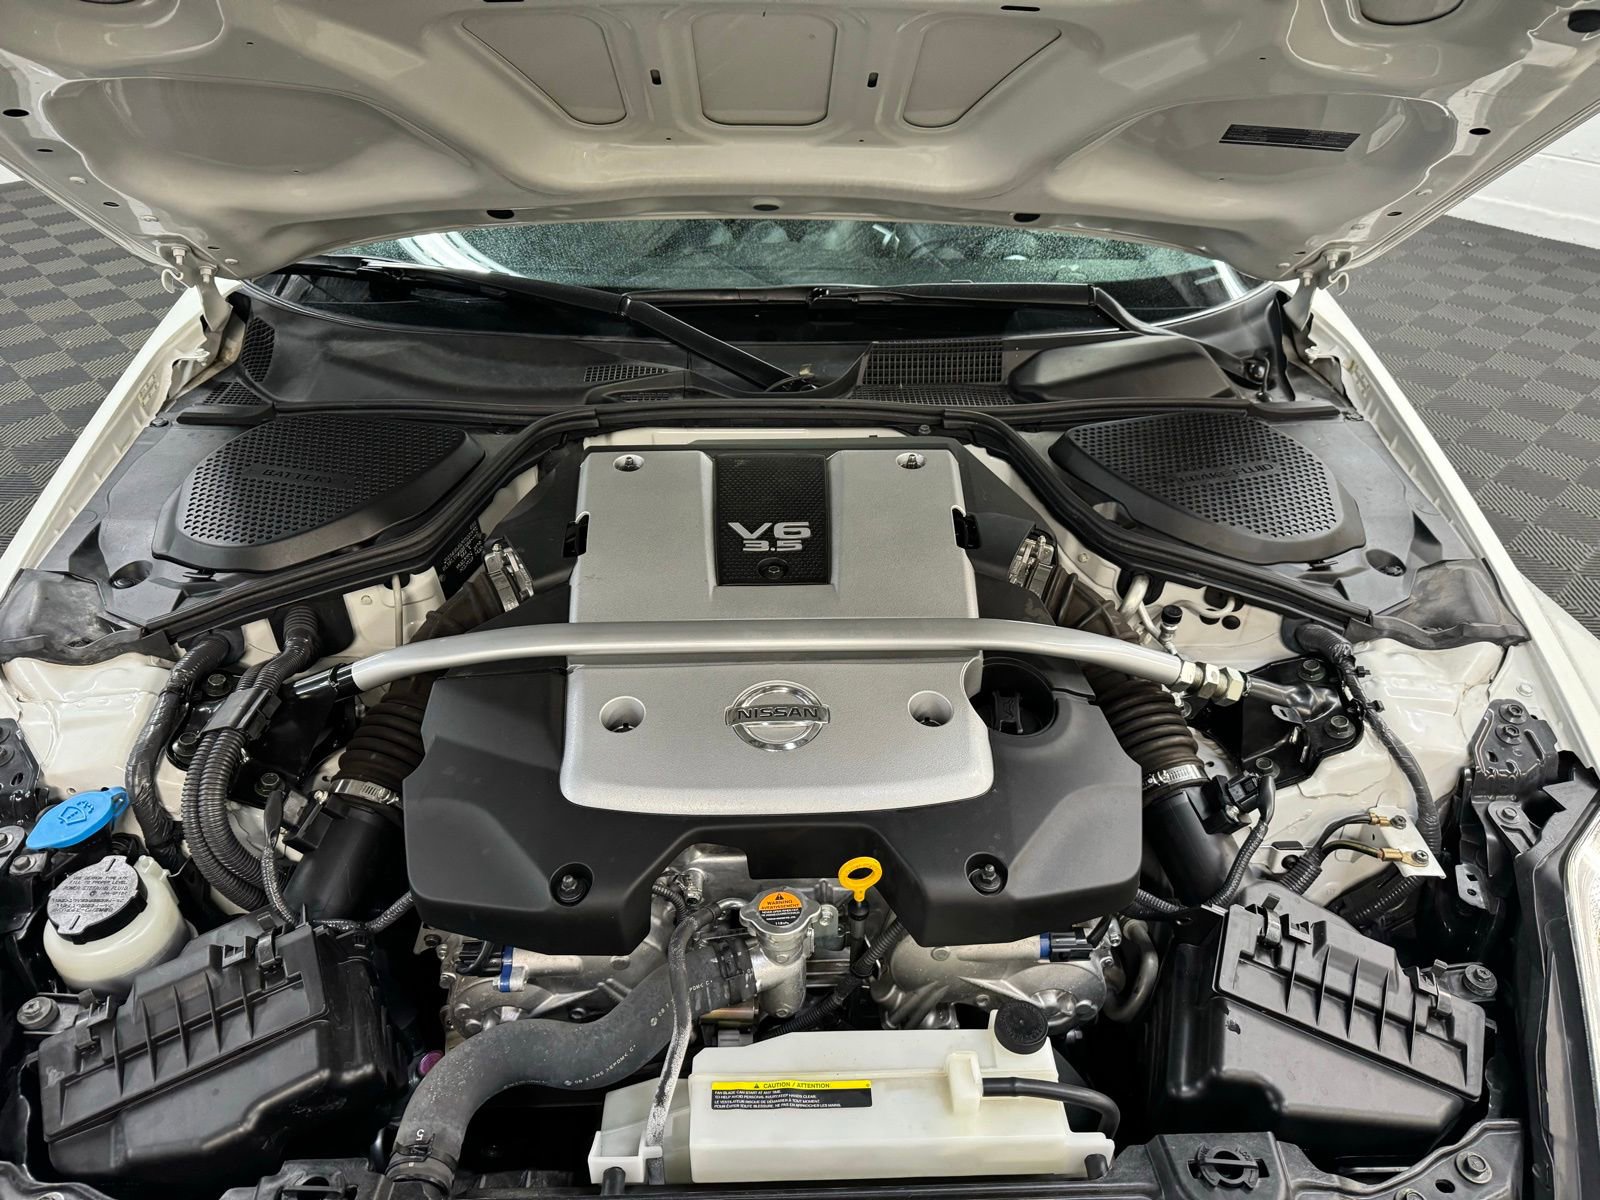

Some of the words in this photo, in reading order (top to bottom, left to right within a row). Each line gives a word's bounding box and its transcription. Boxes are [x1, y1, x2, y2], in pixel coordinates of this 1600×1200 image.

[1232, 463, 1274, 475] FLUID
[727, 521, 811, 539] V6
[742, 539, 803, 552] 3.5
[737, 707, 818, 720] NISSAN
[763, 1081, 791, 1089] CAUTION
